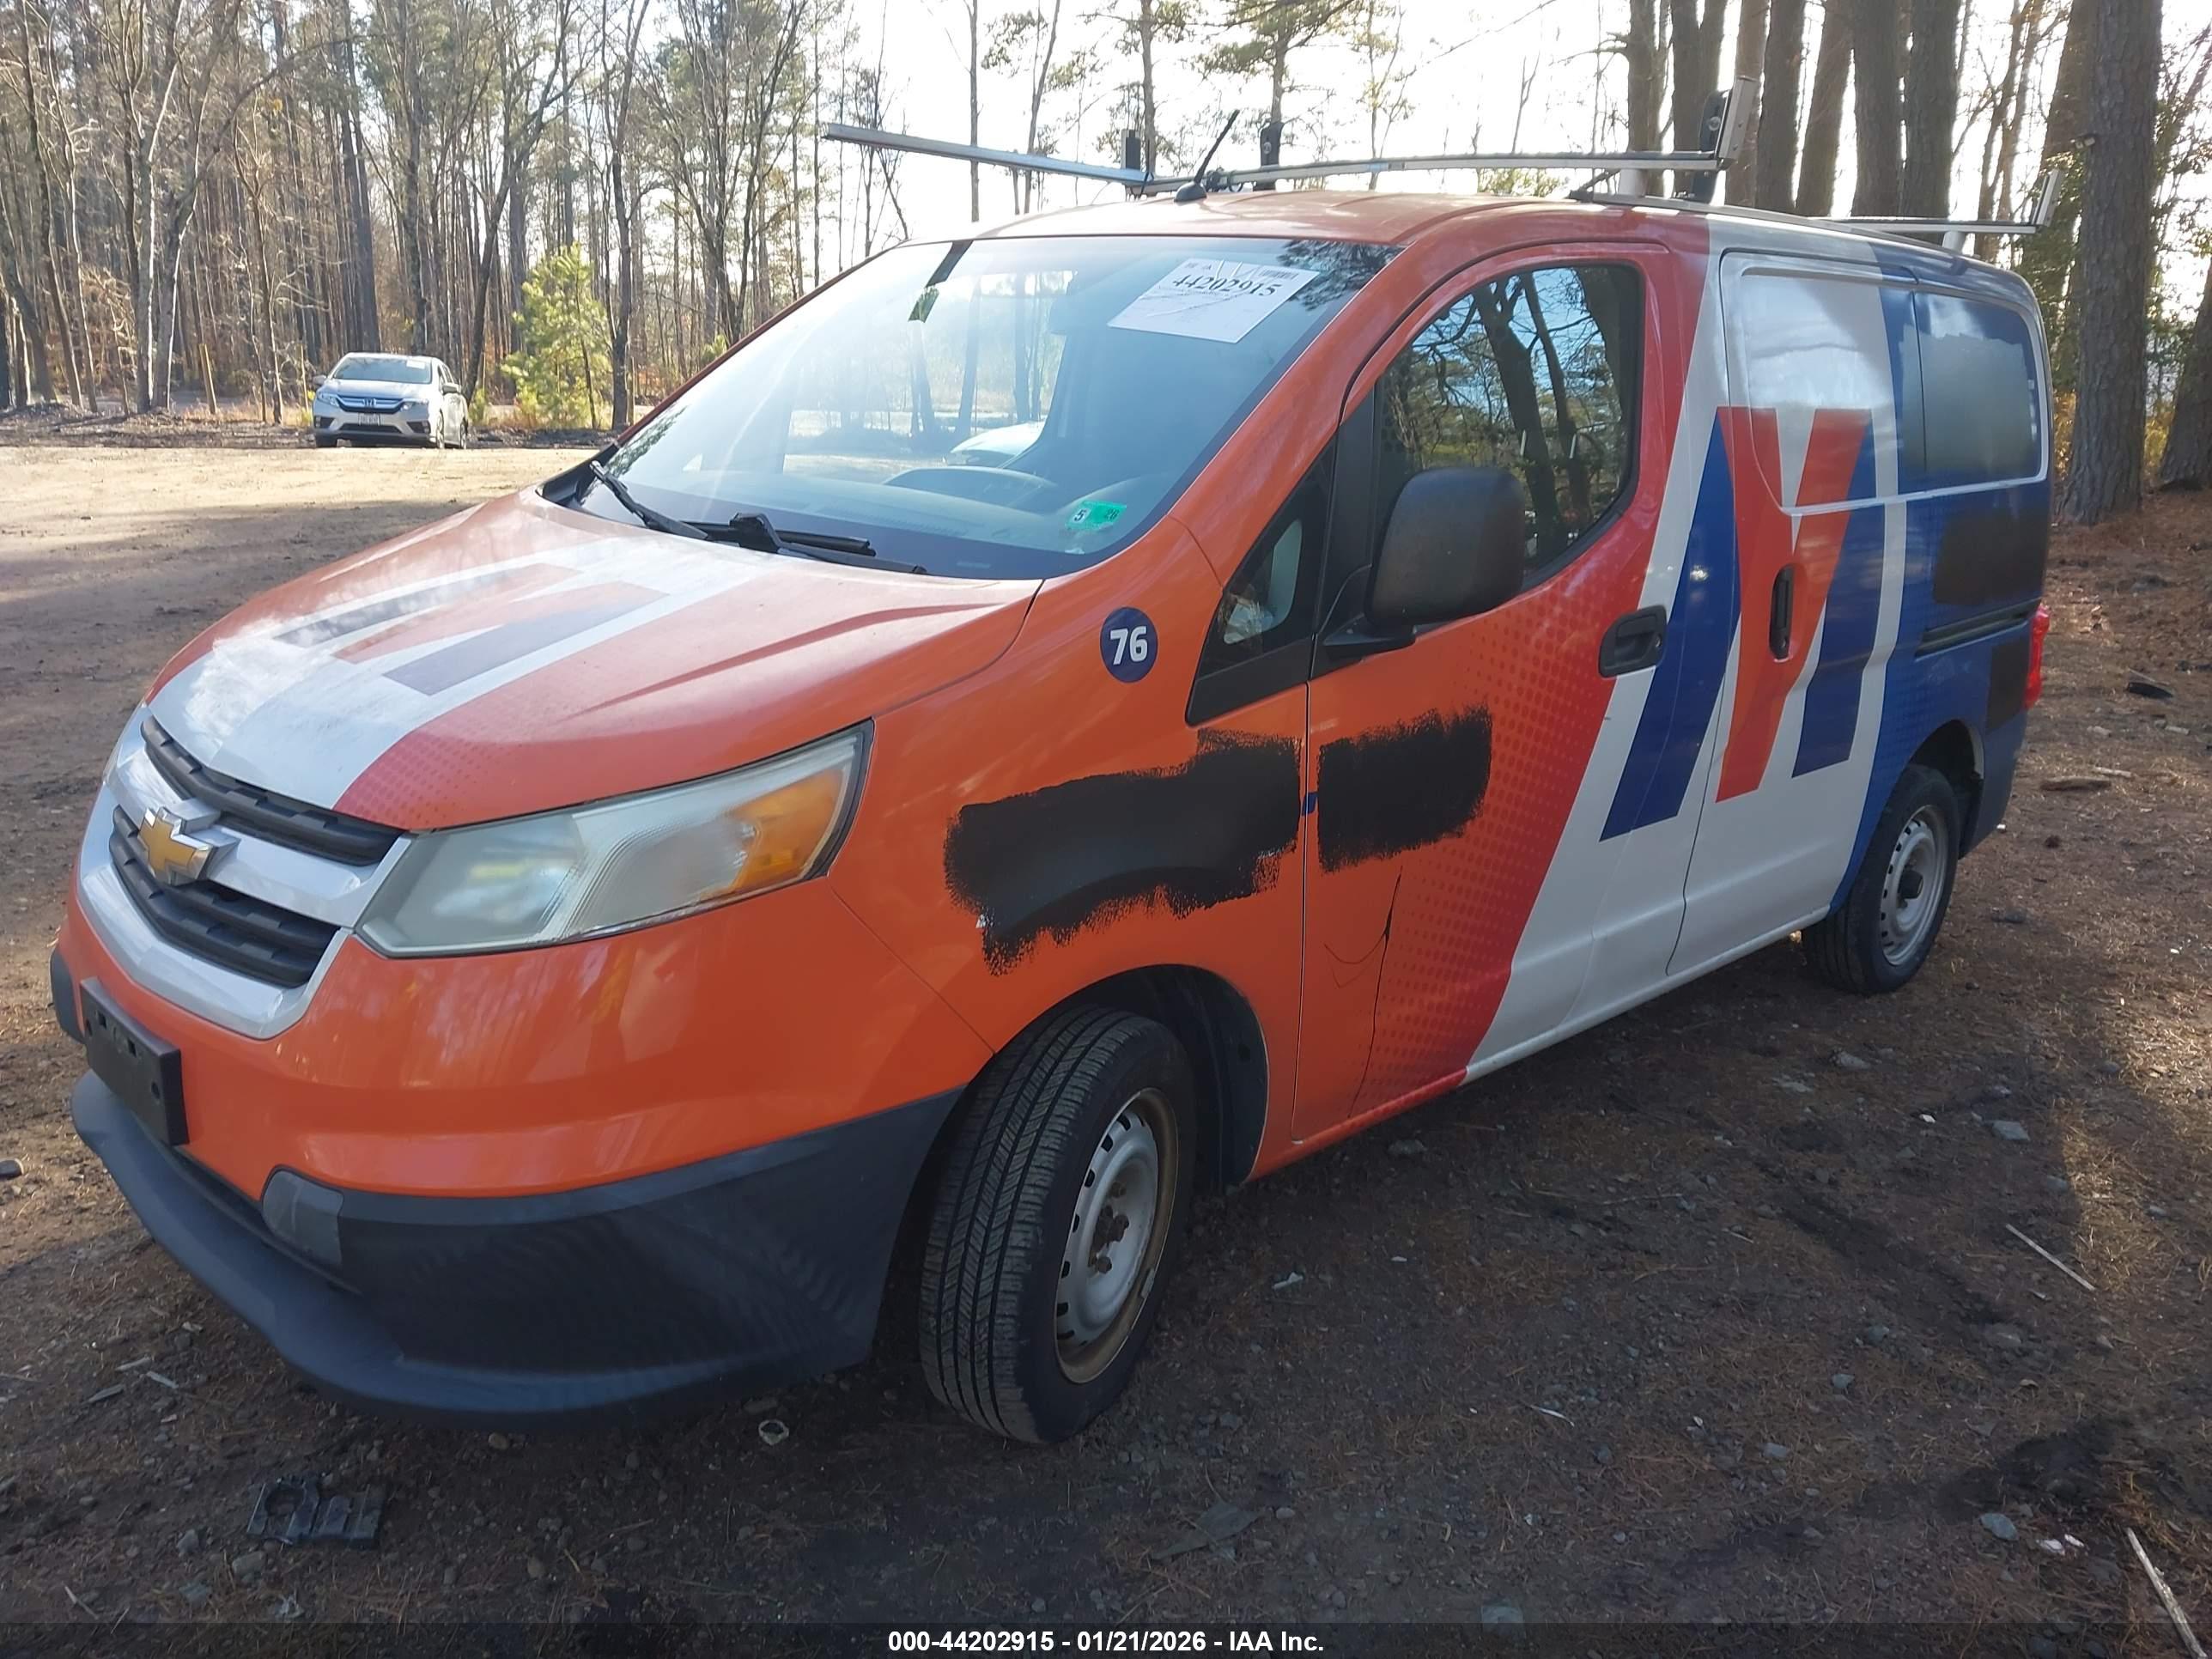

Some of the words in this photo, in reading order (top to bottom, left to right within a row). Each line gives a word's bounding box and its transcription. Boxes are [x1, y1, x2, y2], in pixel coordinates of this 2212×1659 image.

[1172, 274, 1282, 296] 44202915
[1073, 507, 1087, 522] 5
[1109, 625, 1148, 665] 76
